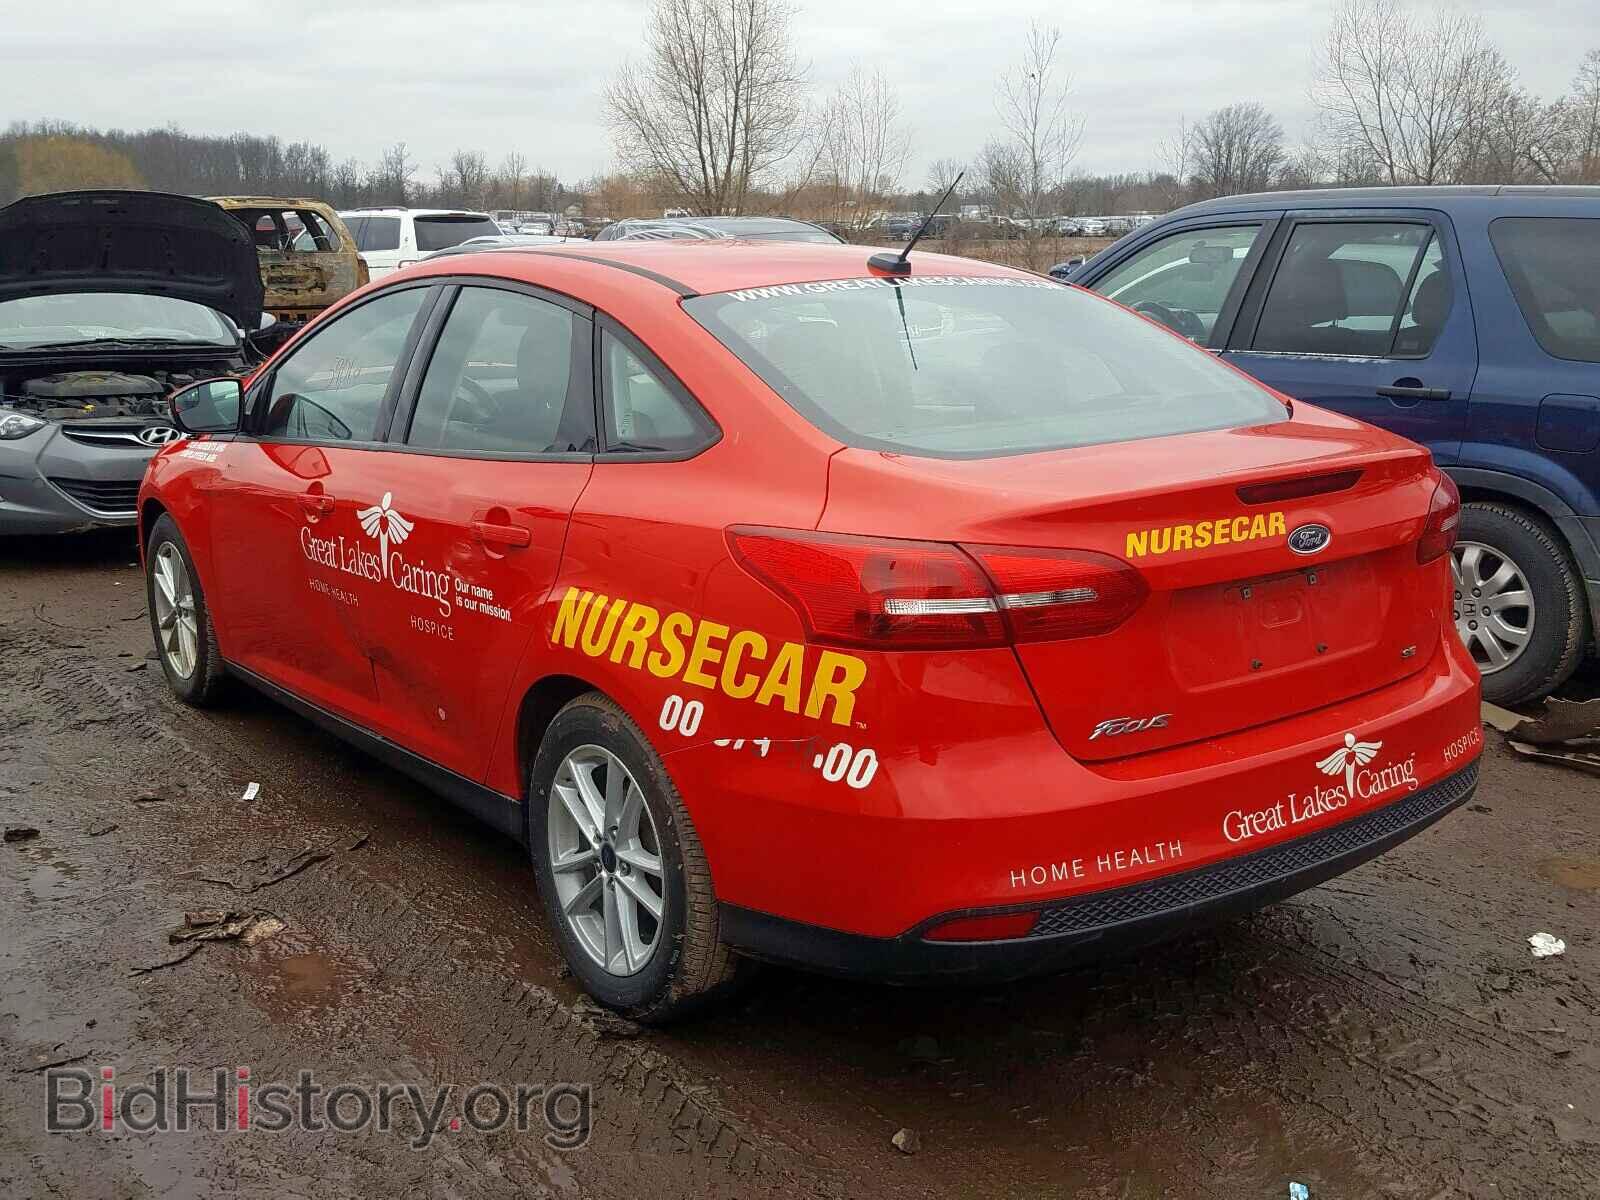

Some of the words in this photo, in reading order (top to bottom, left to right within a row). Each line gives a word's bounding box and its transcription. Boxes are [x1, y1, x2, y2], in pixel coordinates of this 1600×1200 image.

[1126, 511, 1286, 558] NURSECAR
[301, 526, 337, 571] Great
[340, 536, 381, 583] Lakes
[390, 551, 451, 618] Caring
[455, 577, 470, 593] Our
[471, 582, 493, 600] name
[330, 586, 359, 608] HEALTH
[455, 594, 463, 605] is
[464, 598, 478, 611] our
[479, 603, 512, 622] mission.
[410, 615, 454, 641] HOSPICE
[551, 586, 867, 726] NURSECAR
[1443, 727, 1480, 761] HOSPICE
[1222, 801, 1286, 843] Great
[1289, 783, 1348, 824] Lakes
[1356, 754, 1418, 799] Caring
[1009, 858, 1085, 888] HOME
[1097, 839, 1183, 874] HEALTH
